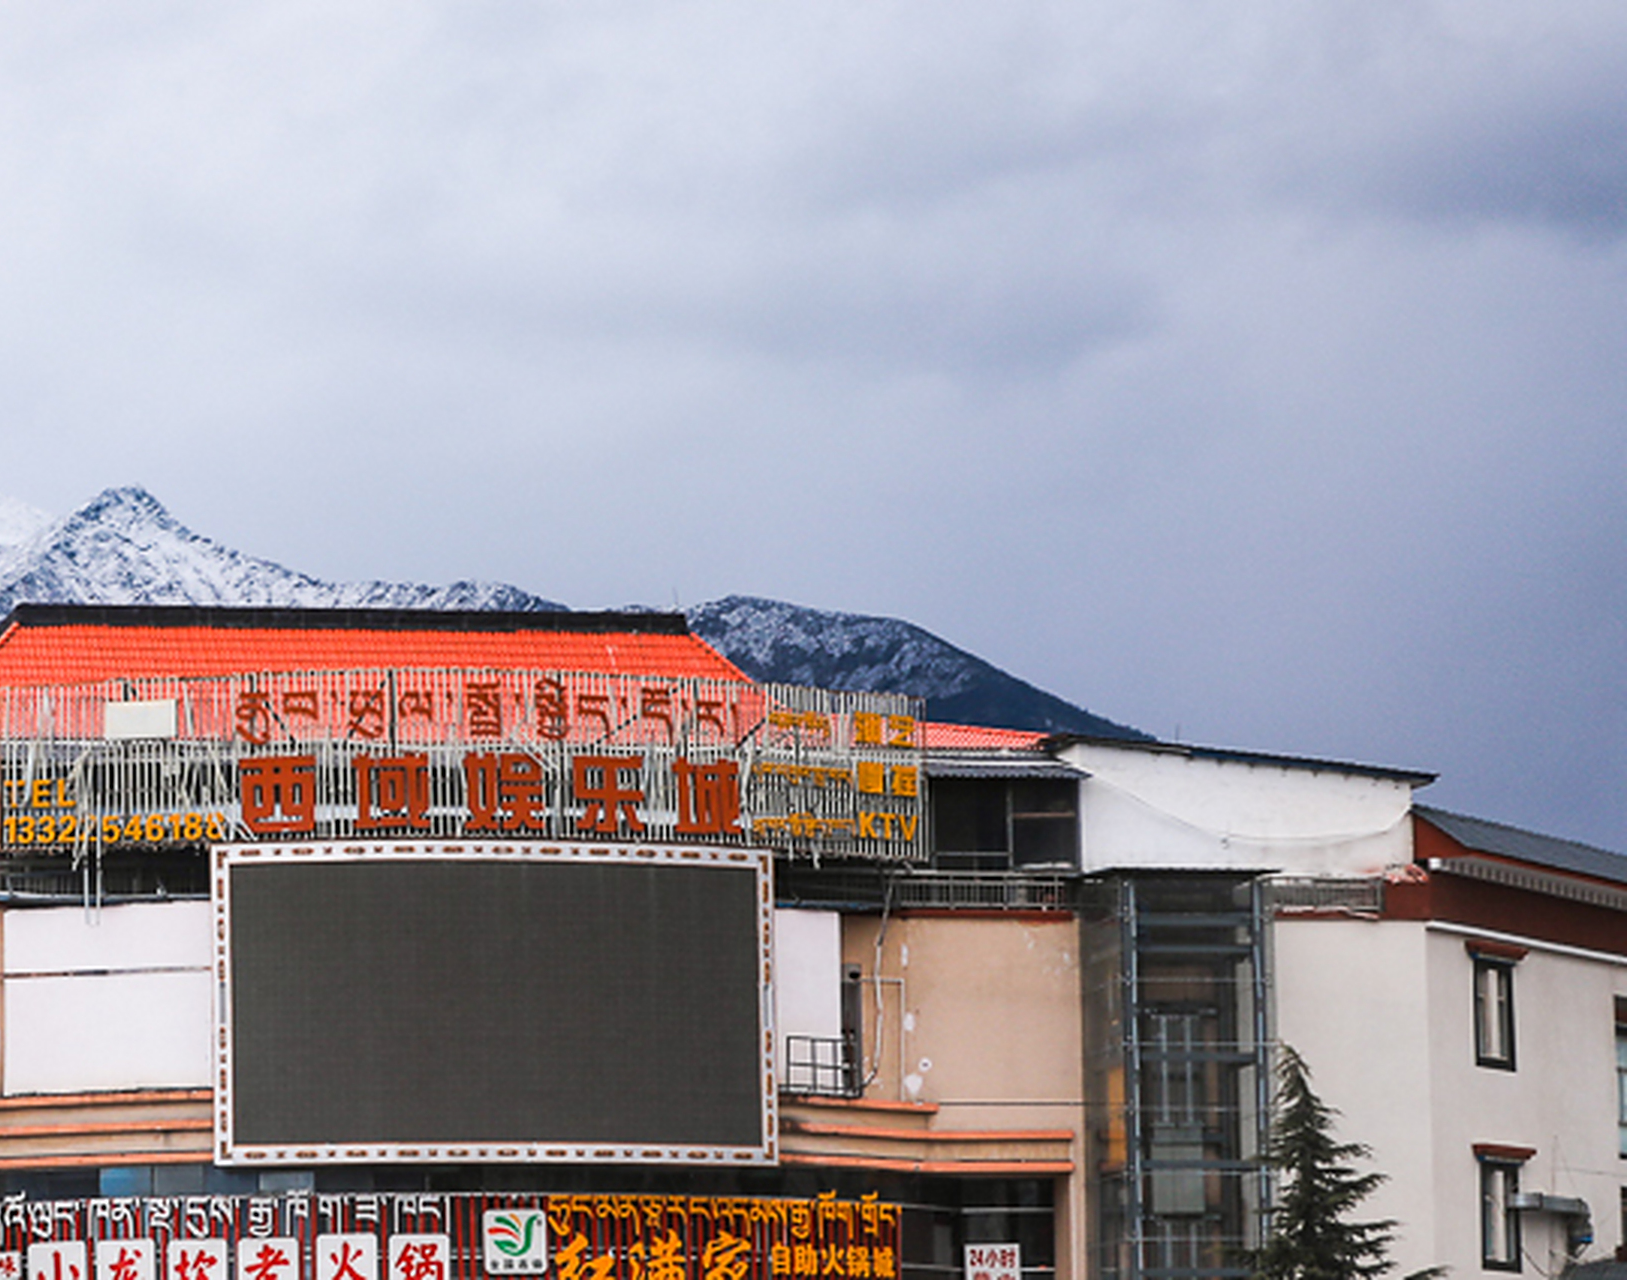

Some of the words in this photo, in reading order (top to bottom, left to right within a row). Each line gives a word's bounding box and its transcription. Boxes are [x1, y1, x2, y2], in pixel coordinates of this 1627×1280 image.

[238, 751, 743, 834] 西域娱乐城
[858, 811, 917, 841] KTV
[771, 1241, 896, 1278] 自助火锅城
